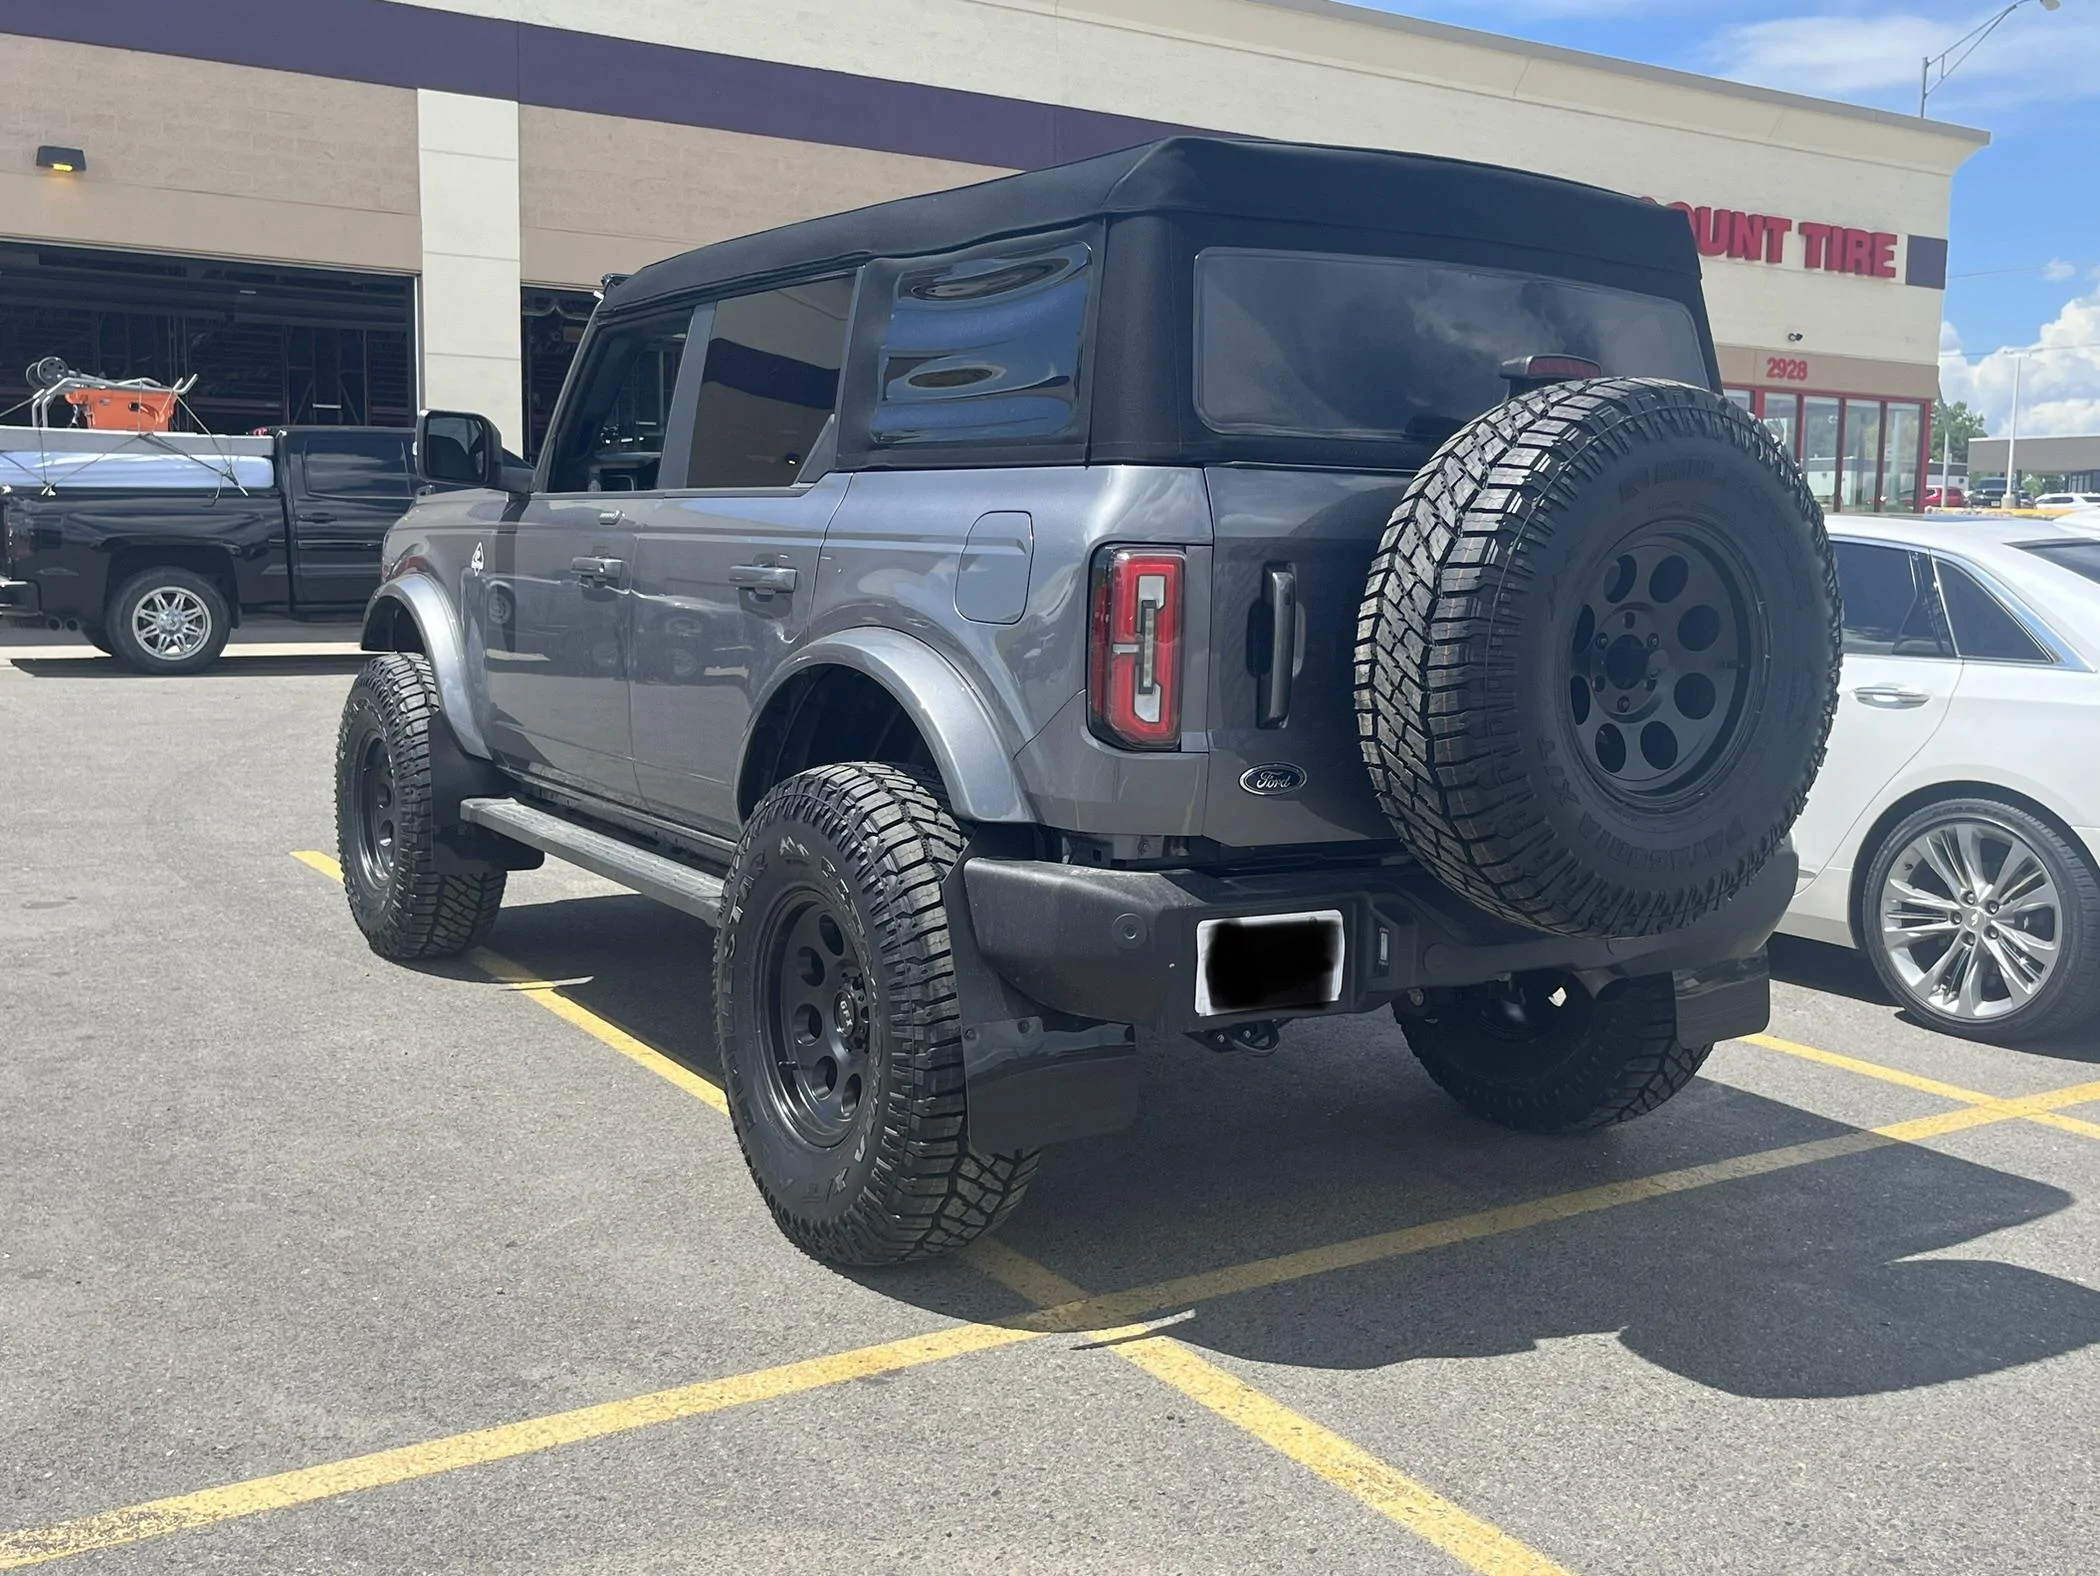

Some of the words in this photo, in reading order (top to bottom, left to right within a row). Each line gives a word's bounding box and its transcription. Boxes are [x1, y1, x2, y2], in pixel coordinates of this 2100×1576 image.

[1798, 222, 1898, 278] TIRE
[1766, 356, 1808, 381] 2928
[1256, 770, 1291, 788] Ford
